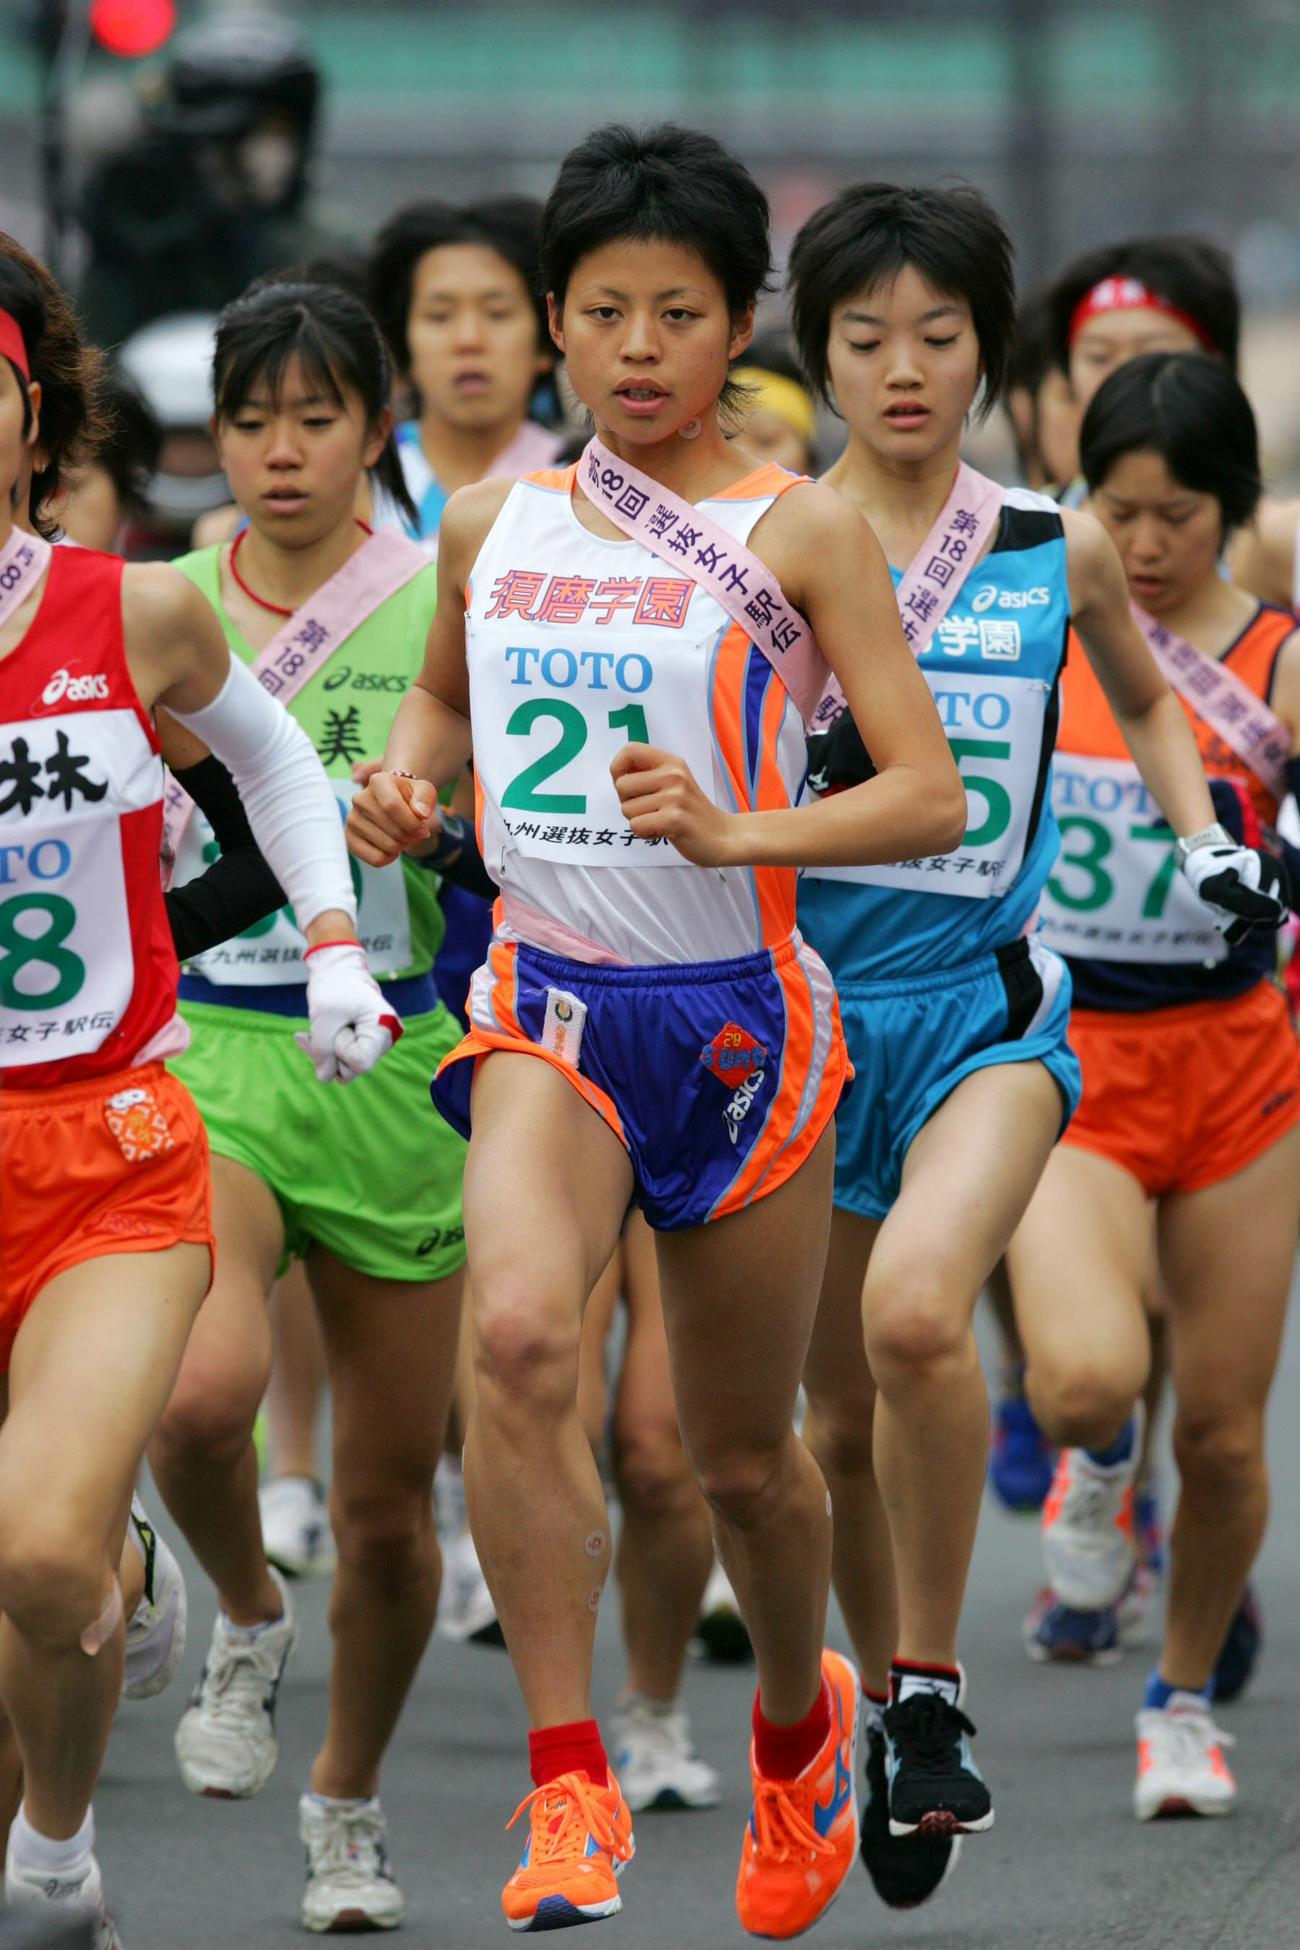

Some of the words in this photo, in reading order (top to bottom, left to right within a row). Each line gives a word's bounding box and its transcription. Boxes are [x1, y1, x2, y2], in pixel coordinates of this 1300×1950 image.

[485, 570, 697, 629] 須磨学園
[998, 587, 1050, 609] asics
[921, 615, 1022, 662] 学園
[351, 673, 408, 693] asics
[505, 647, 654, 693] TOTO
[316, 705, 367, 767] 美
[1047, 815, 1178, 920] 37
[0, 891, 86, 1012] 8
[0, 1010, 115, 1044] 女子駅伝
